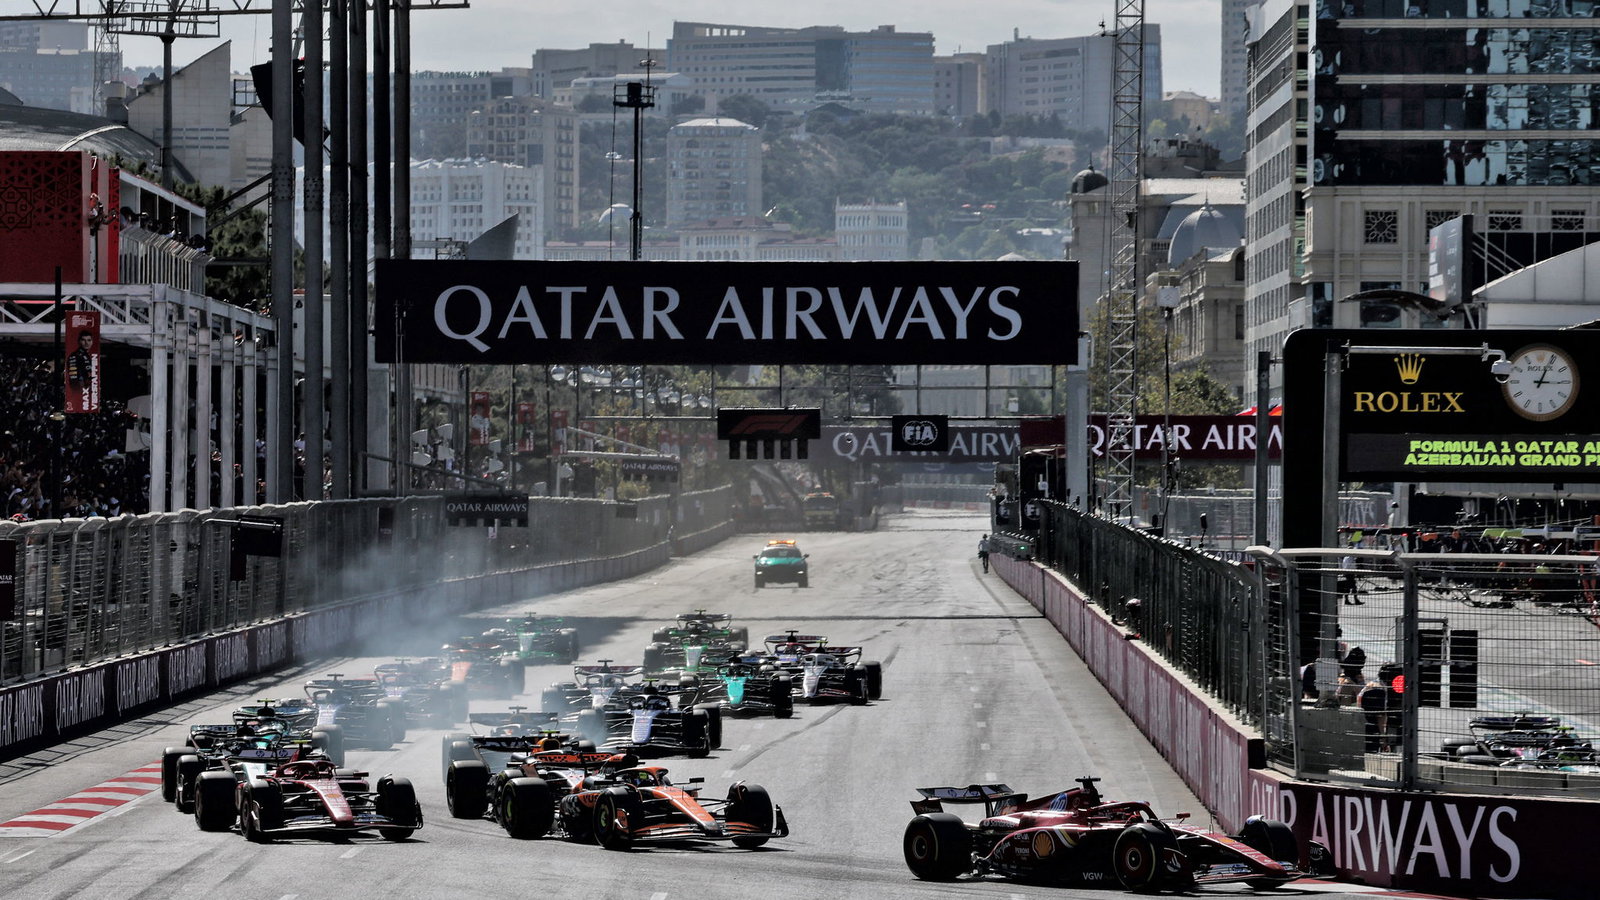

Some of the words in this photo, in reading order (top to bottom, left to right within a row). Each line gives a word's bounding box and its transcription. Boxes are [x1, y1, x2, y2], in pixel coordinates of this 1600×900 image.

[434, 285, 685, 353] QATAR
[705, 286, 1022, 341] AIRWAYS
[1353, 391, 1465, 413] ROLEX
[1410, 441, 1497, 453] FORMULA
[1501, 442, 1511, 453] 1
[1515, 442, 1579, 453] QATAR
[1404, 454, 1515, 466] AZERBAIJAN
[1519, 454, 1582, 466] GRAND
[447, 503, 481, 512] QATAR
[484, 503, 527, 512] AIRWAYS
[1311, 792, 1521, 883] AIRWAYS
[1082, 871, 1104, 881] VGW
